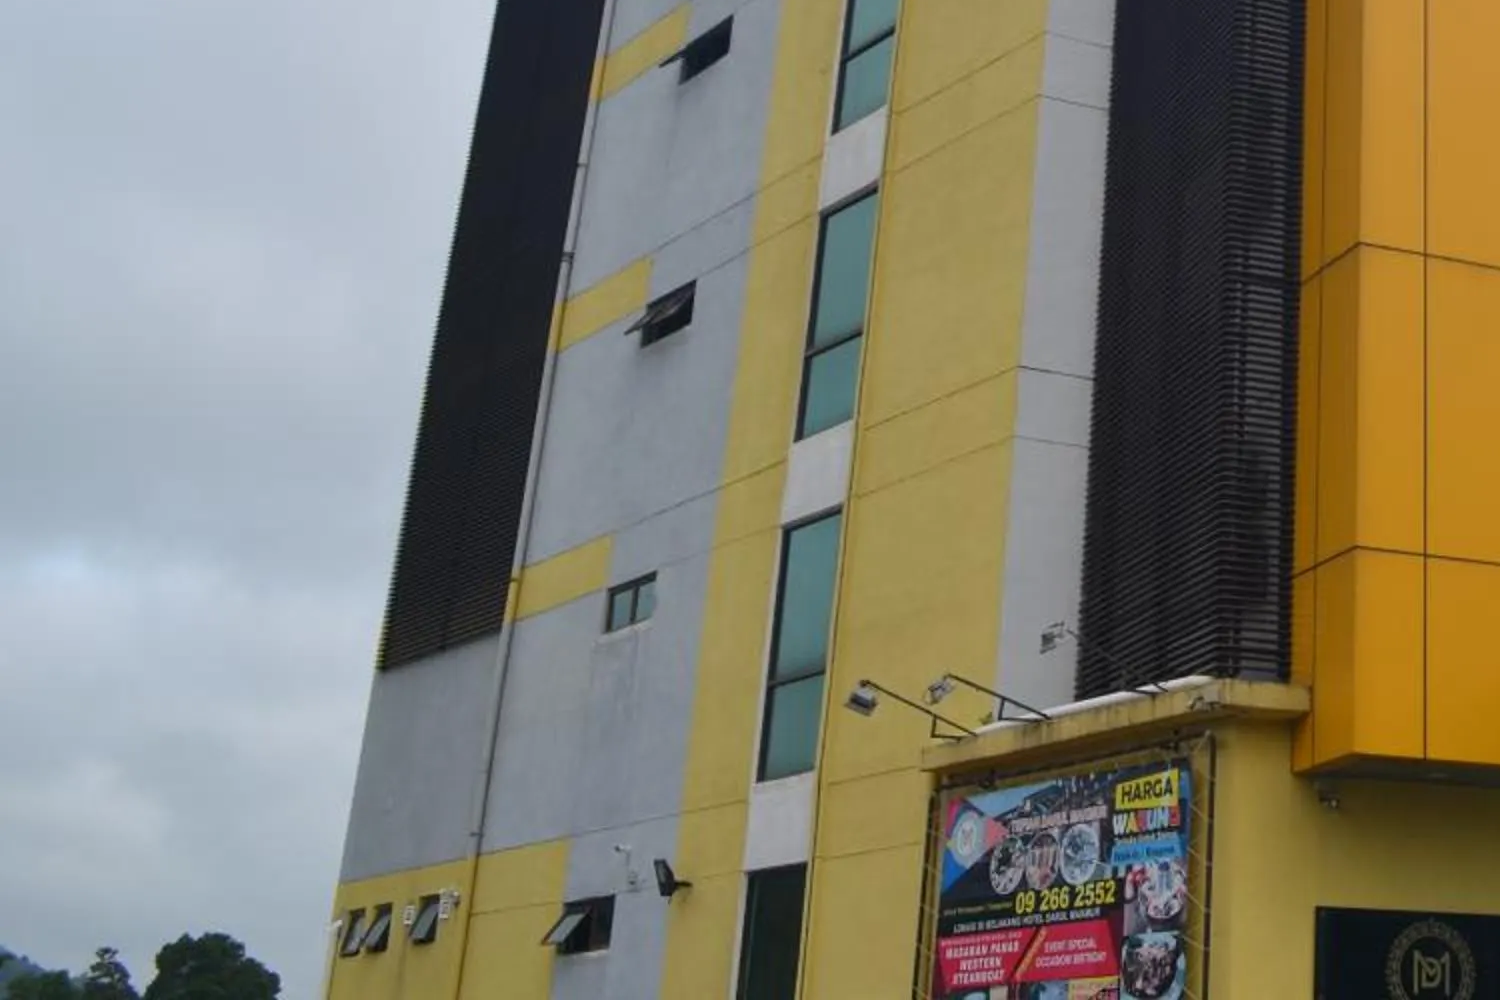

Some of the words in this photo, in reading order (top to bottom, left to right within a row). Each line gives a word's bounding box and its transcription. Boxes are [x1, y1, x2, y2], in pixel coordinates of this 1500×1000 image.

[1120, 777, 1174, 803] HARGA
[1015, 890, 1035, 914] 09
[1039, 885, 1070, 912] 266
[1073, 879, 1117, 907] 2552
[959, 956, 1002, 971] WESTERN
